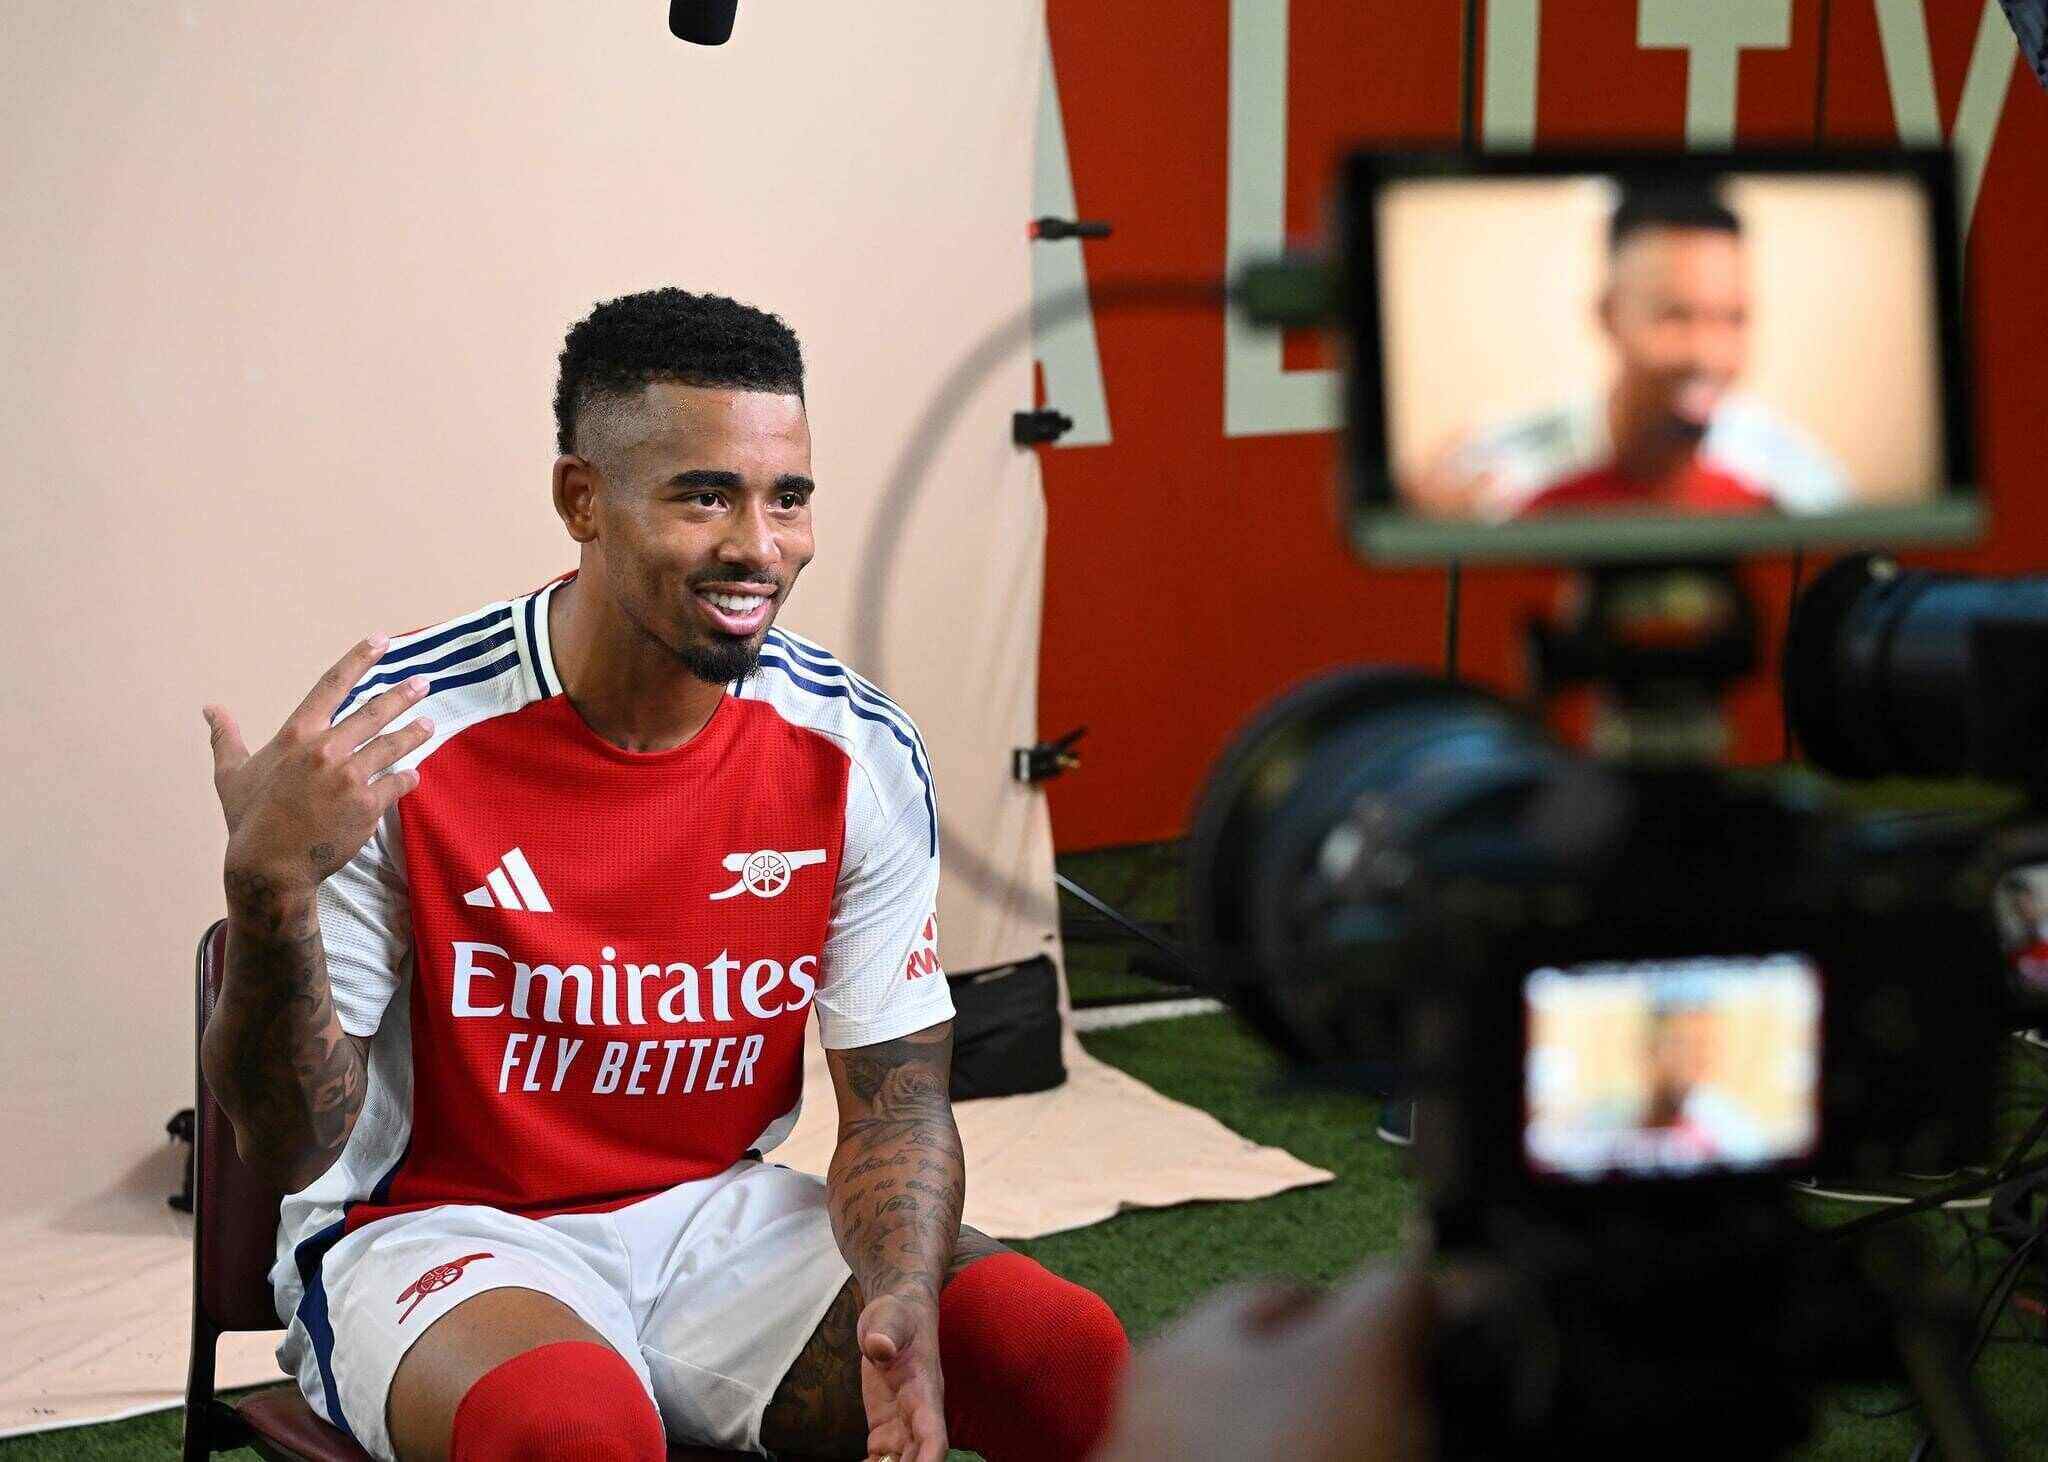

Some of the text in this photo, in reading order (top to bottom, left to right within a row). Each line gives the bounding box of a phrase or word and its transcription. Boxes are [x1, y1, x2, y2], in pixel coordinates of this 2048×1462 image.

[451, 940, 817, 1026] Emirates
[498, 1033, 764, 1095] FLY BETTER
